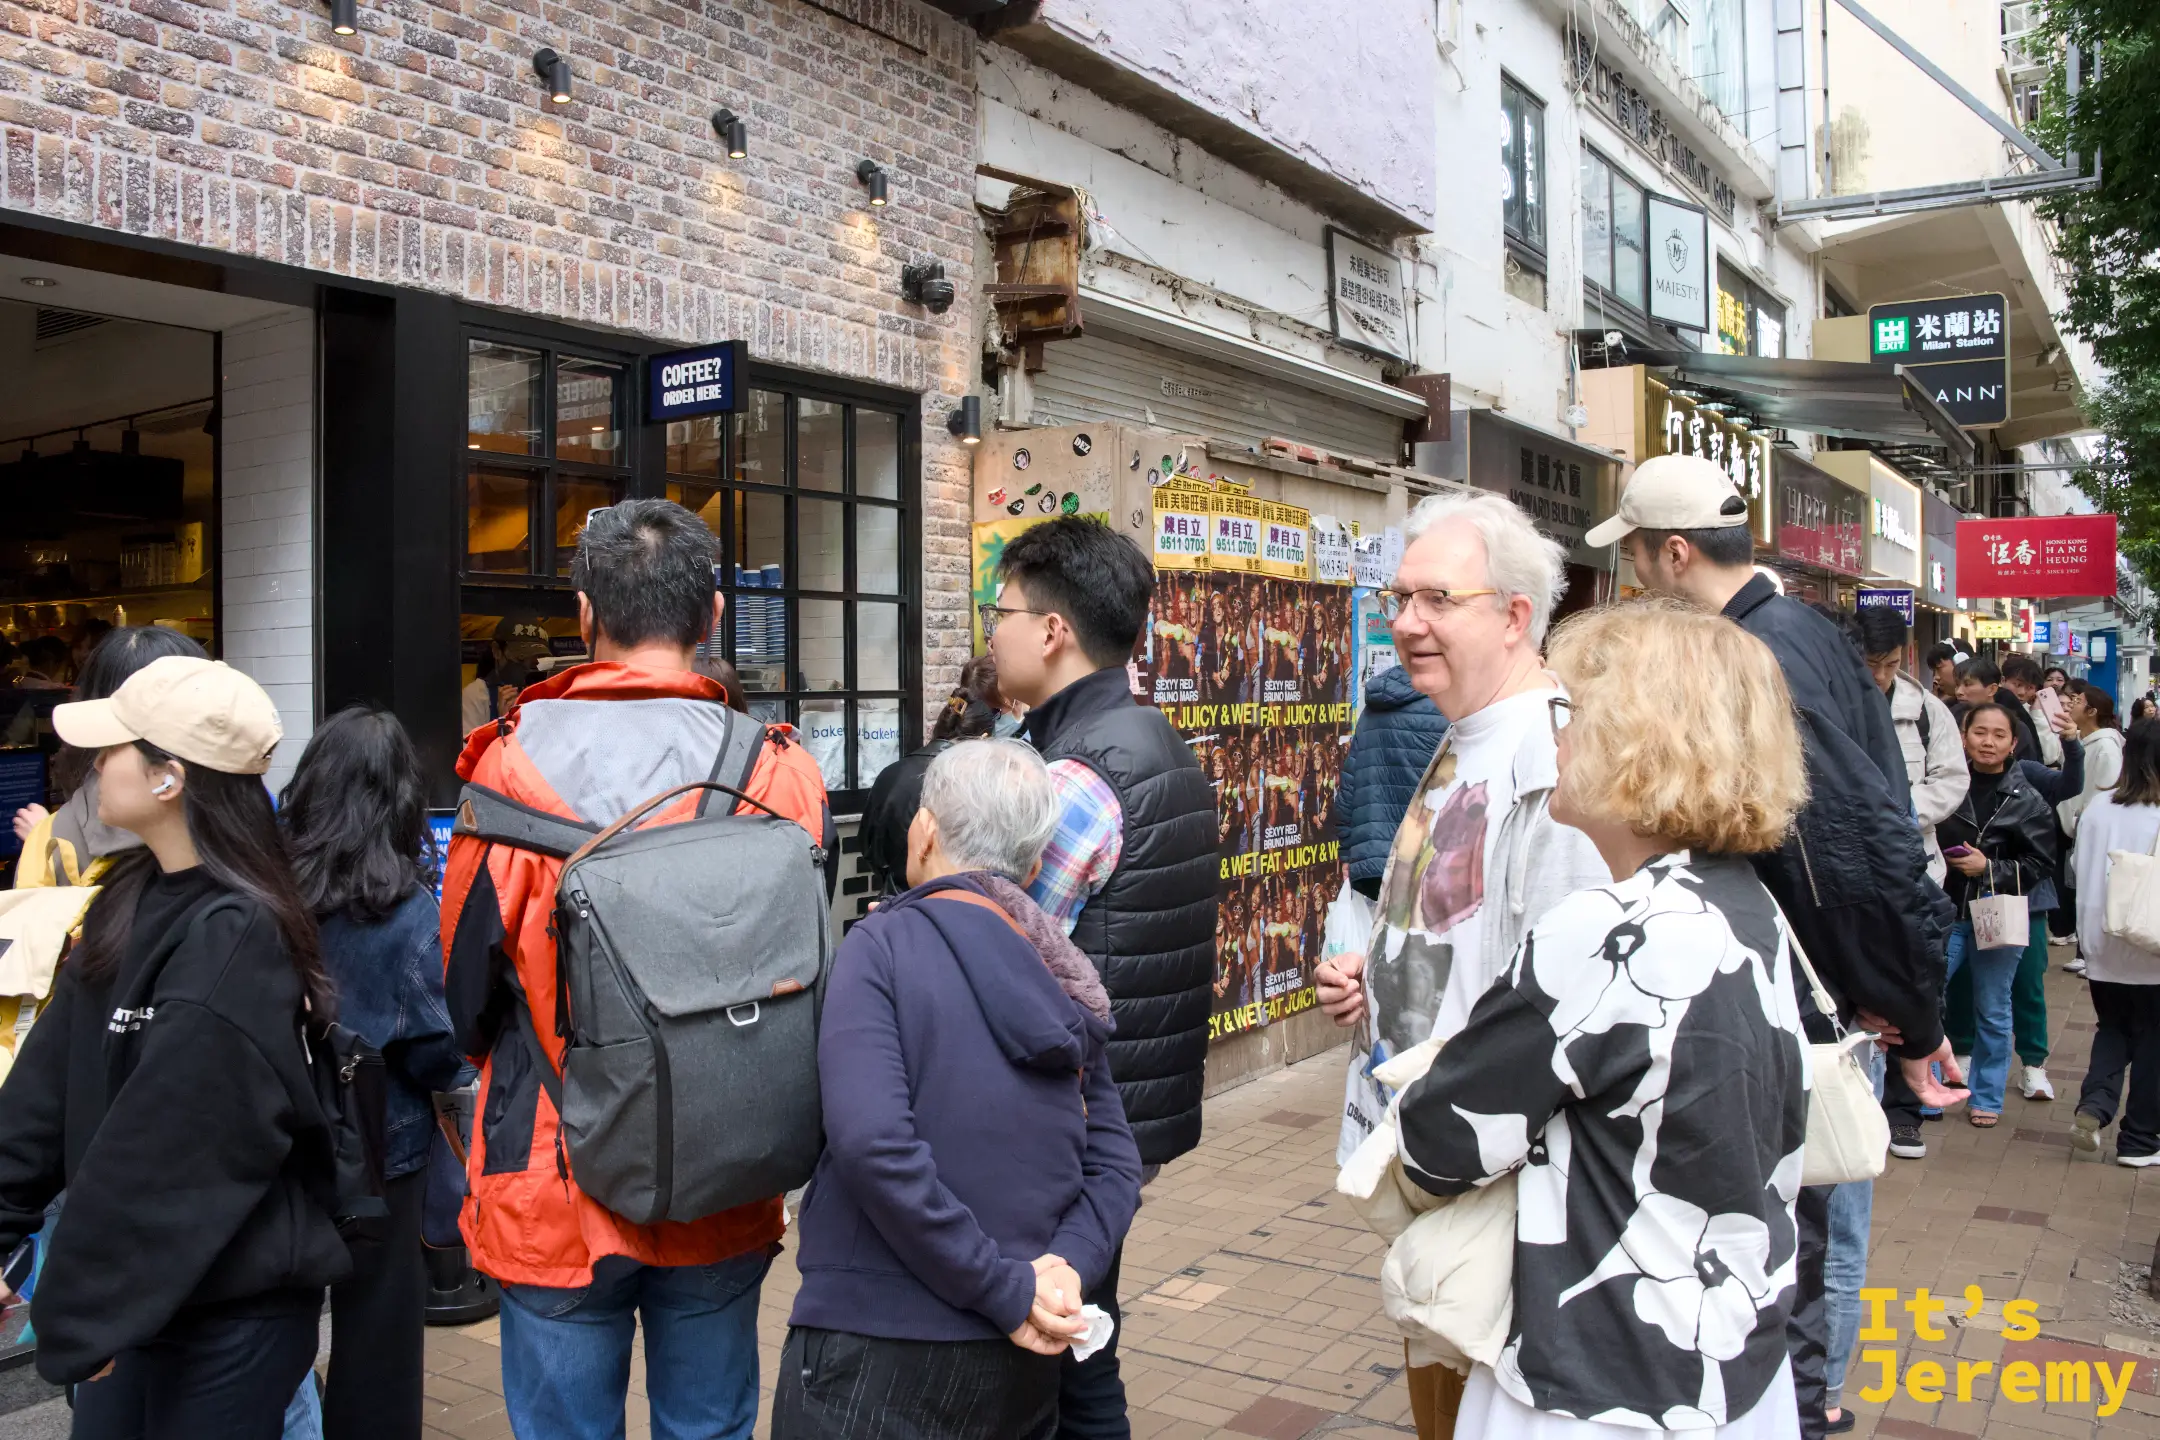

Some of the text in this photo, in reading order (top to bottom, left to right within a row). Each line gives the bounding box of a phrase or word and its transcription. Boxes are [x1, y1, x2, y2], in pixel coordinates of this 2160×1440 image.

[1656, 278, 1699, 301] MAJESTY
[1915, 309, 2000, 339] 米蘭站
[1879, 341, 1905, 351] EXIT
[1922, 337, 1994, 351] Milan Station
[662, 357, 722, 388] COFFEE?
[663, 383, 722, 407] ORDER HERE
[1552, 501, 1591, 528] BUILDING
[1787, 486, 1827, 534] HARRY
[1164, 515, 1202, 537] 陳自立
[1219, 518, 1254, 540] 陳自立
[1160, 535, 1206, 552] 9511 0703
[1216, 537, 1257, 555] 9511 0703
[1270, 526, 1301, 548] 陳自立
[1266, 544, 1305, 563] 9511 0703
[2045, 545, 2088, 554] HANG
[2046, 555, 2088, 564] HEUNG
[1860, 595, 1909, 606] HARRY LEE
[1155, 678, 1193, 690] SEXYY RED
[1265, 680, 1296, 691] SEXYY RED
[1154, 690, 1199, 703] BRUNO MARS
[1264, 691, 1301, 702] BRUNO MARS
[1178, 704, 1218, 729] JUICY
[1221, 704, 1230, 726] &
[1231, 702, 1260, 725] WET
[1260, 702, 1352, 727] FAT JUICY & WET
[1265, 823, 1298, 839] SEXYY RED
[1264, 834, 1301, 850] BRUNO MARS
[1220, 852, 1259, 879] & WET
[1260, 851, 1281, 875] FAT
[1284, 844, 1318, 870] JUICY
[1319, 842, 1328, 862] &
[1264, 977, 1303, 998] BRUNO MARS
[1265, 967, 1298, 987] SEXYY RED
[1264, 986, 1317, 1021] FAT JUICY
[1224, 1012, 1235, 1033] &
[1233, 1001, 1262, 1029] WET
